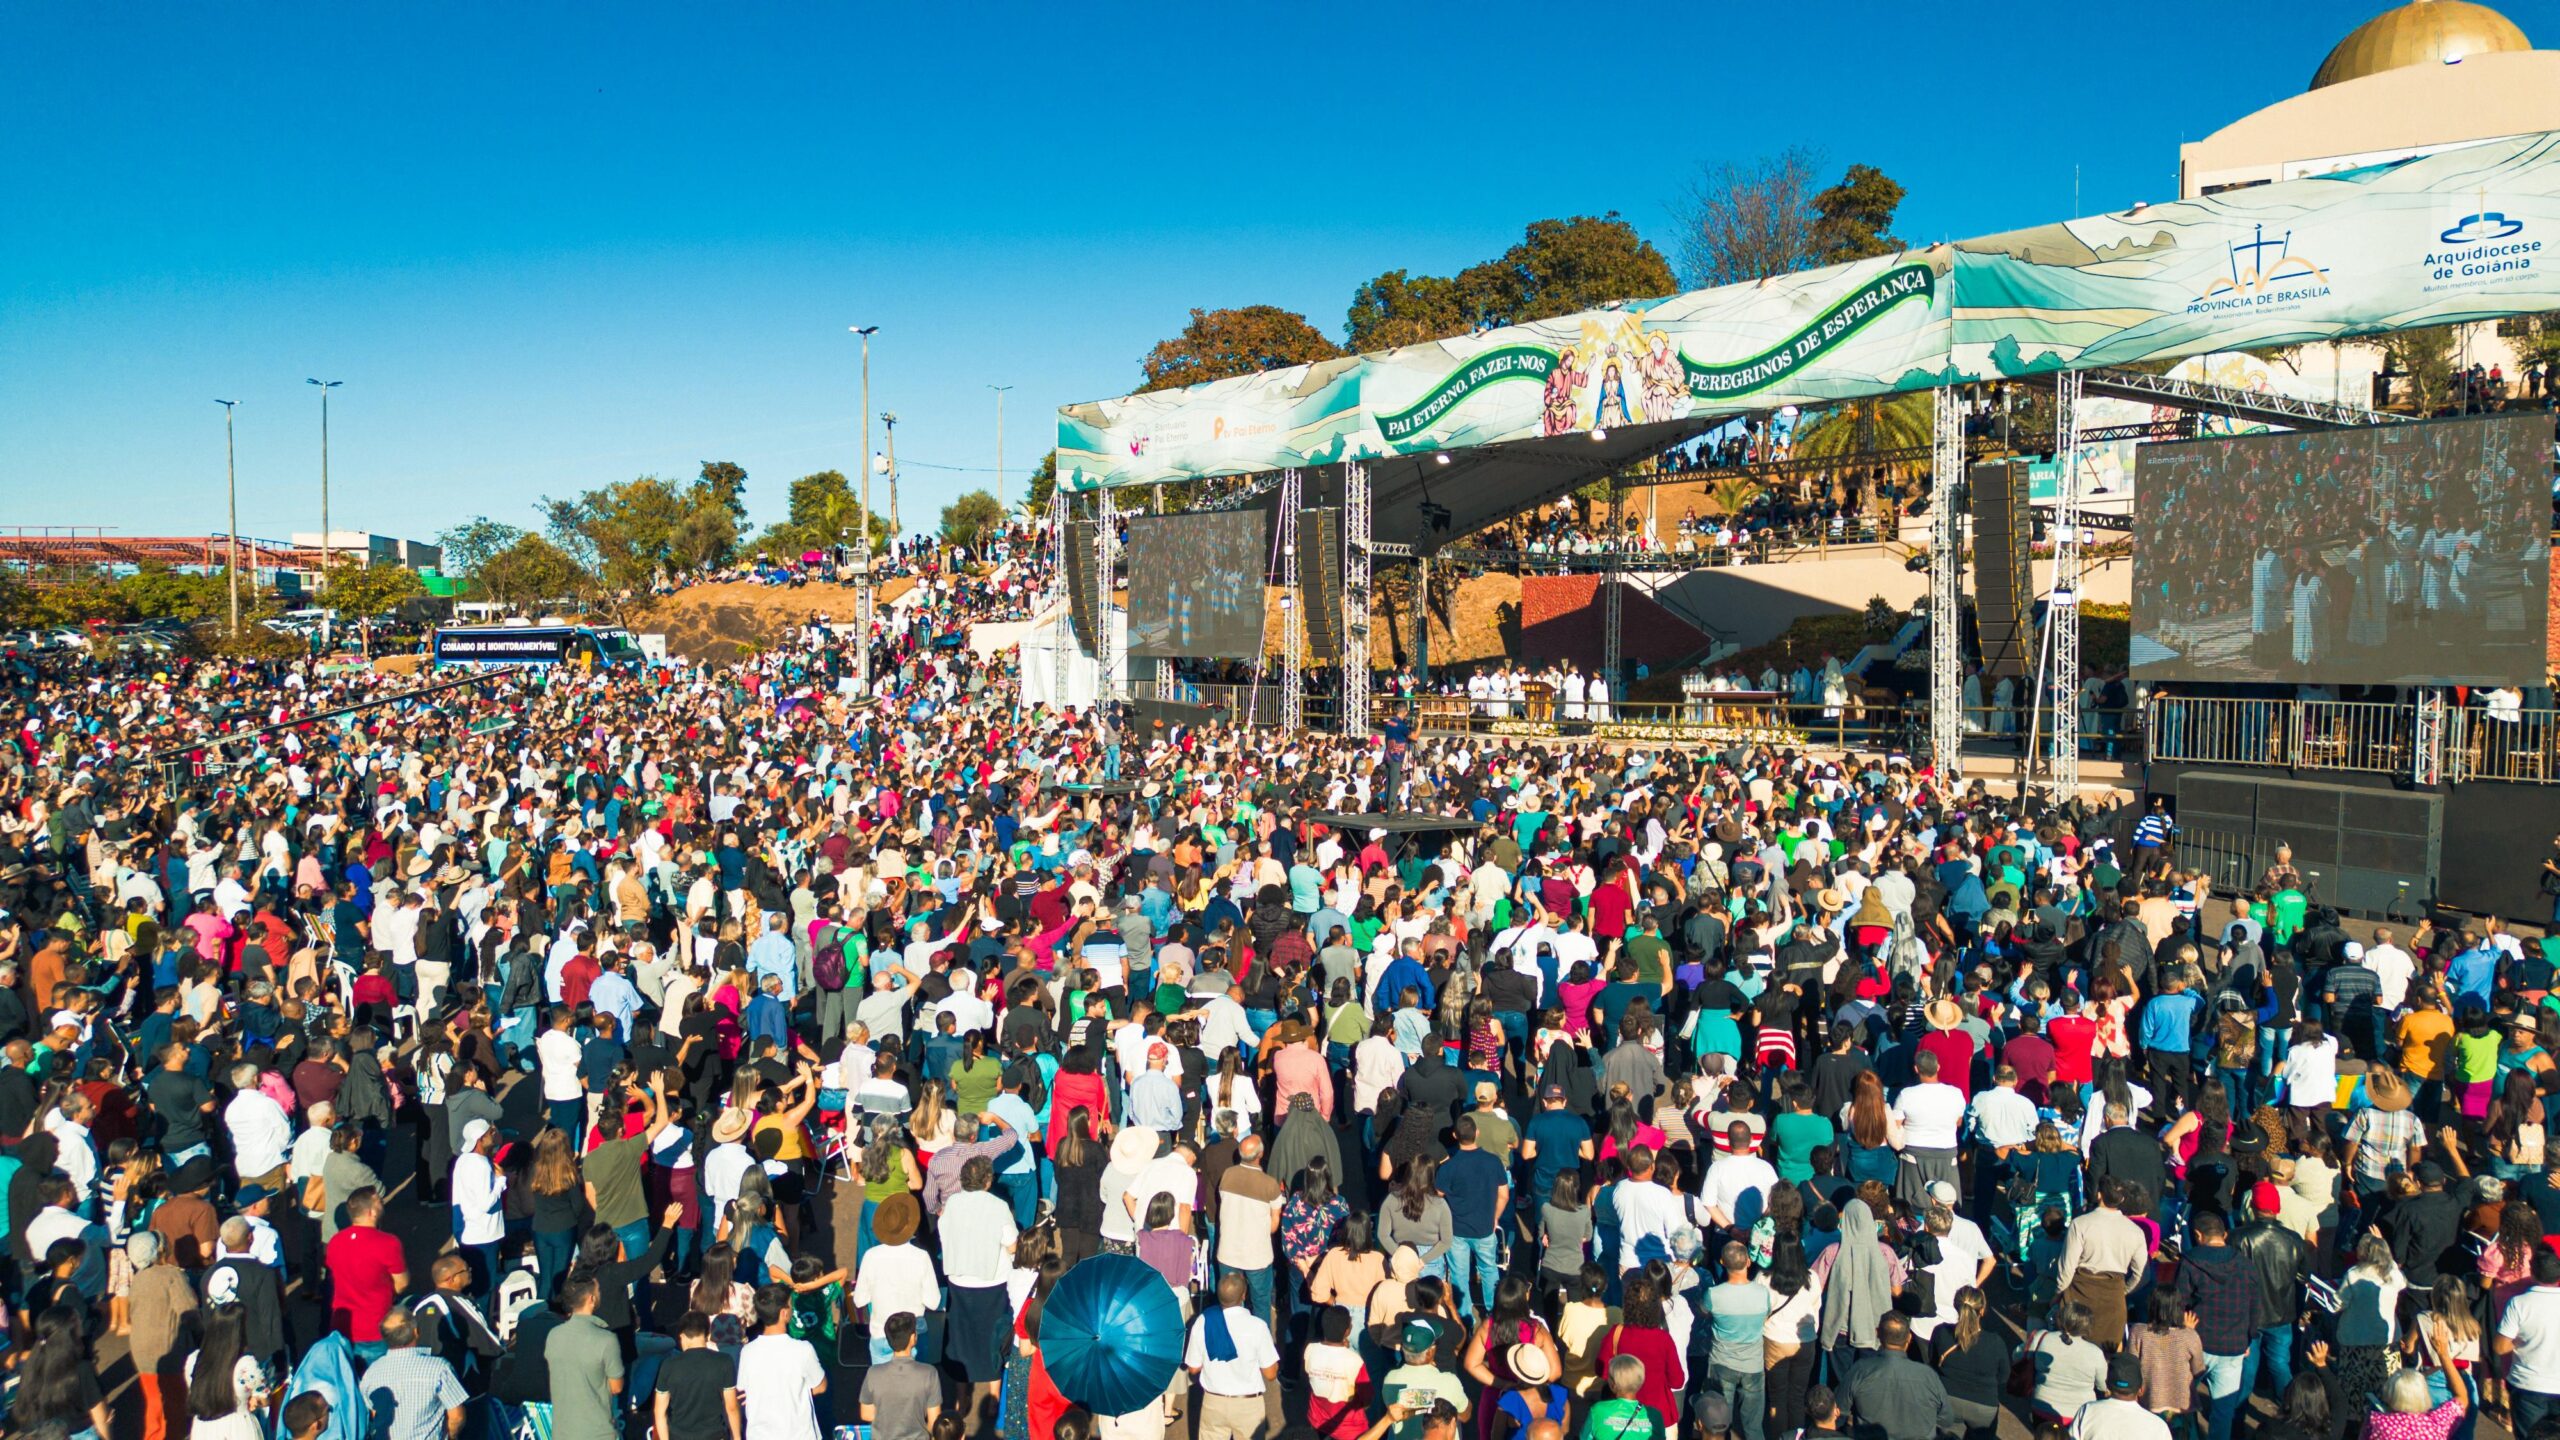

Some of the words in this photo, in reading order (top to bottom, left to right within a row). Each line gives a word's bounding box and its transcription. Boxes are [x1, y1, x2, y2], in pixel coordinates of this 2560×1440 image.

[2424, 241, 2541, 266] Arquidiocese
[2433, 267, 2454, 280] de
[2462, 257, 2530, 276] Goiânia
[2257, 293, 2273, 305] DE
[1689, 350, 1793, 391] PEREGRINOS
[1796, 330, 1822, 359] DE
[1822, 270, 1927, 341] ESPERANÇA
[1388, 418, 1411, 436] PAI
[1414, 379, 1468, 428] ETERNO,
[1469, 355, 1548, 385] FAZEI-NOS
[1233, 427, 1247, 438] Pai
[1248, 423, 1277, 437] Eterno
[441, 642, 476, 652] COMANDO
[476, 642, 487, 651] DE
